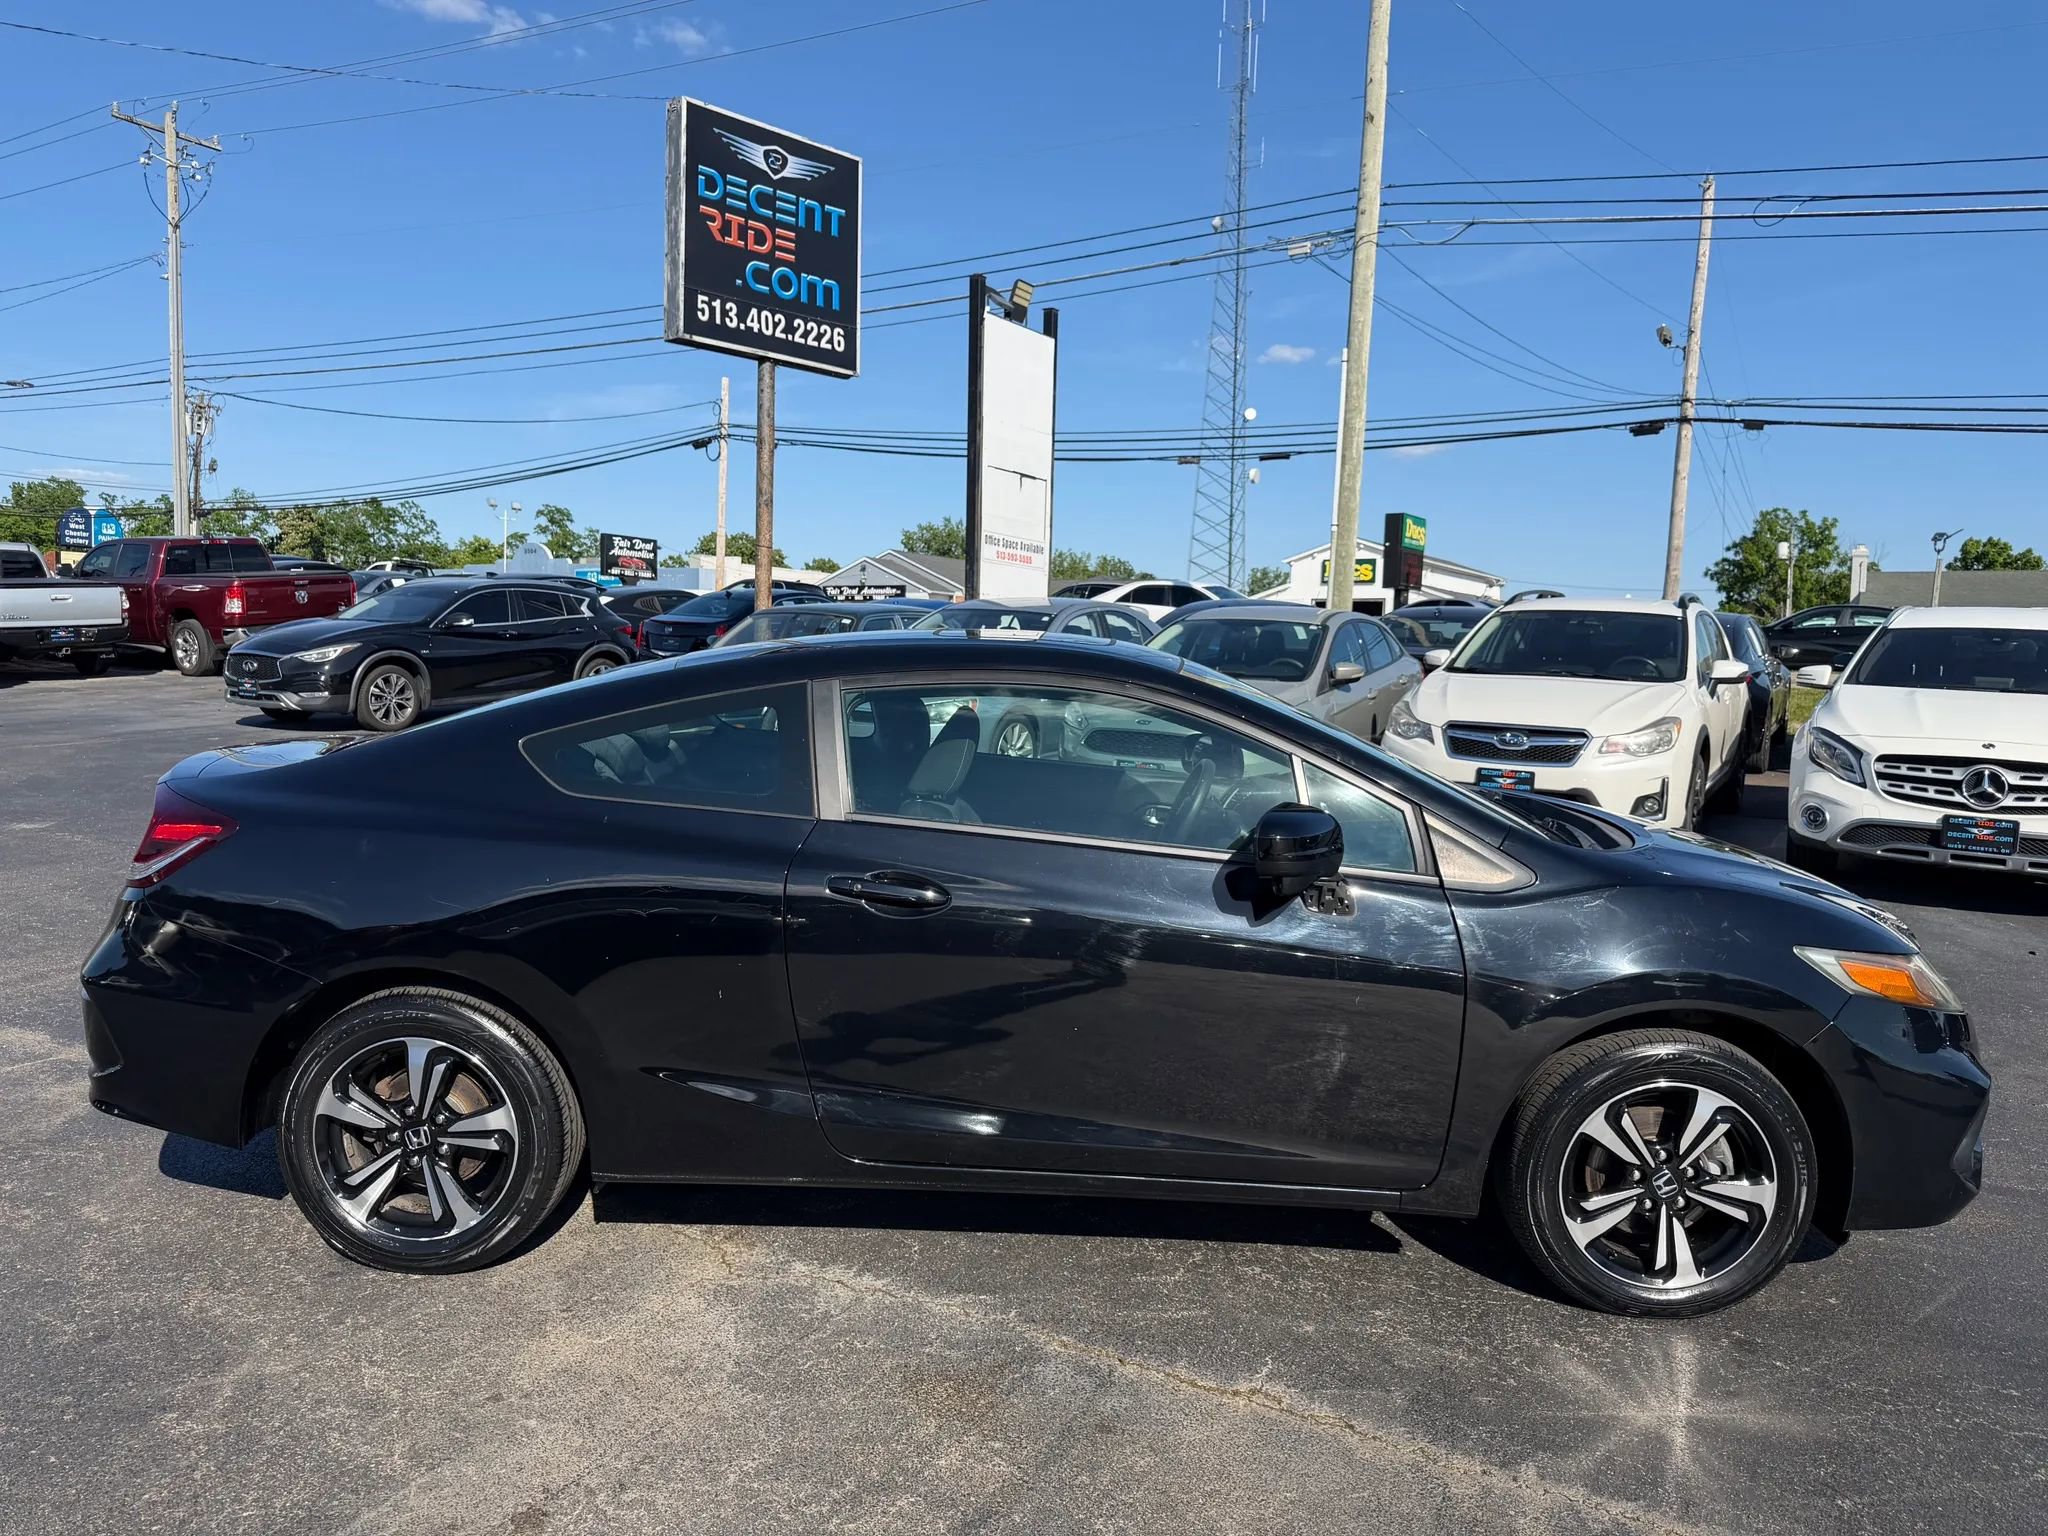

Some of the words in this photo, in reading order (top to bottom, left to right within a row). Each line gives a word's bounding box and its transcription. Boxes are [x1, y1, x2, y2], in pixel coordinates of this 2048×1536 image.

[699, 205, 796, 262] RIDE
[697, 294, 845, 352] 513.402.2226
[69, 522, 85, 530] West
[65, 537, 88, 545] Cyclery
[612, 536, 631, 548] Fair
[632, 538, 654, 550] Deal
[985, 534, 1001, 547] Office
[1002, 537, 1019, 550] Space
[1020, 541, 1044, 555] Available
[609, 546, 655, 559] Automotive
[826, 586, 840, 596] Fair
[841, 586, 859, 595] Deal
